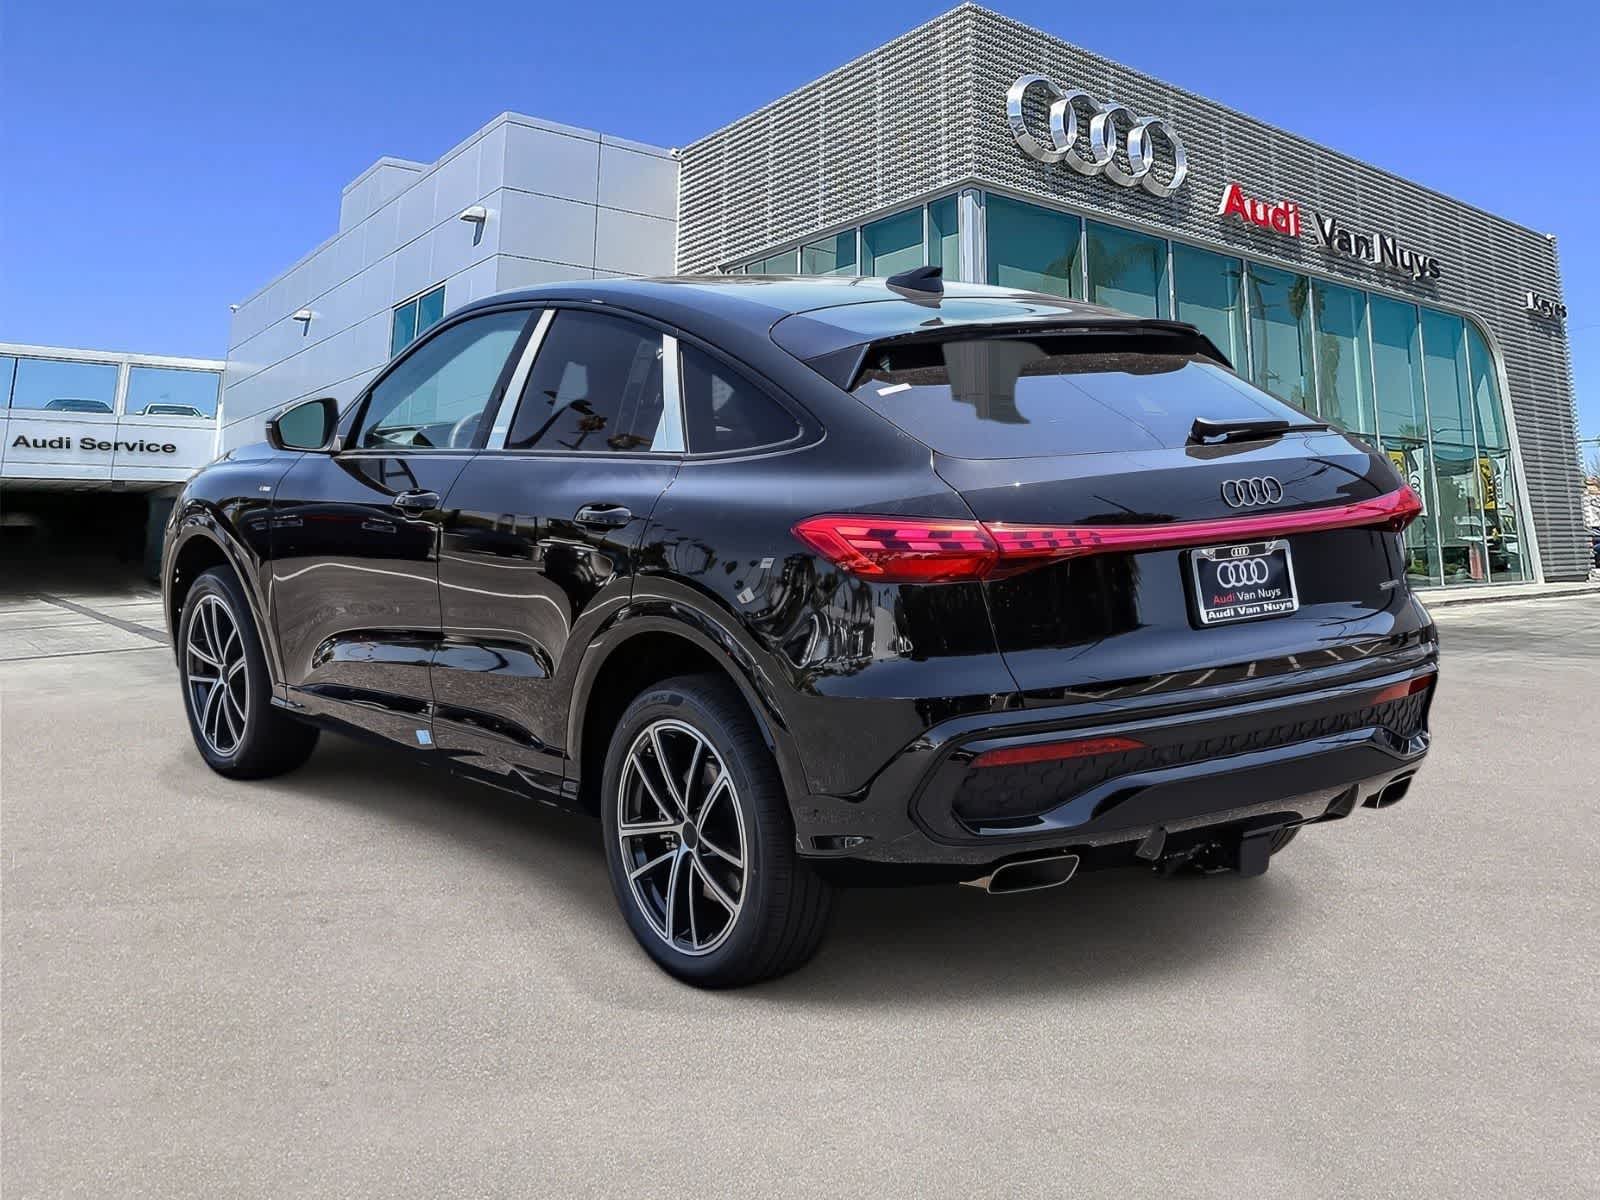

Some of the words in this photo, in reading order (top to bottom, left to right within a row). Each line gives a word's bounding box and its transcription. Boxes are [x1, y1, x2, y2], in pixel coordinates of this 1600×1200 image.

[1218, 182, 1301, 238] Audi
[1311, 211, 1370, 260] Van
[1373, 232, 1441, 280] Nuys
[12, 435, 71, 450] Audi
[80, 437, 177, 454] Service
[1213, 593, 1235, 605] Audi
[1237, 591, 1256, 601] Van
[1258, 588, 1281, 599] Nuys
[1208, 609, 1235, 620] Audi
[1238, 606, 1261, 616] Van
[1263, 601, 1293, 612] Nuys
